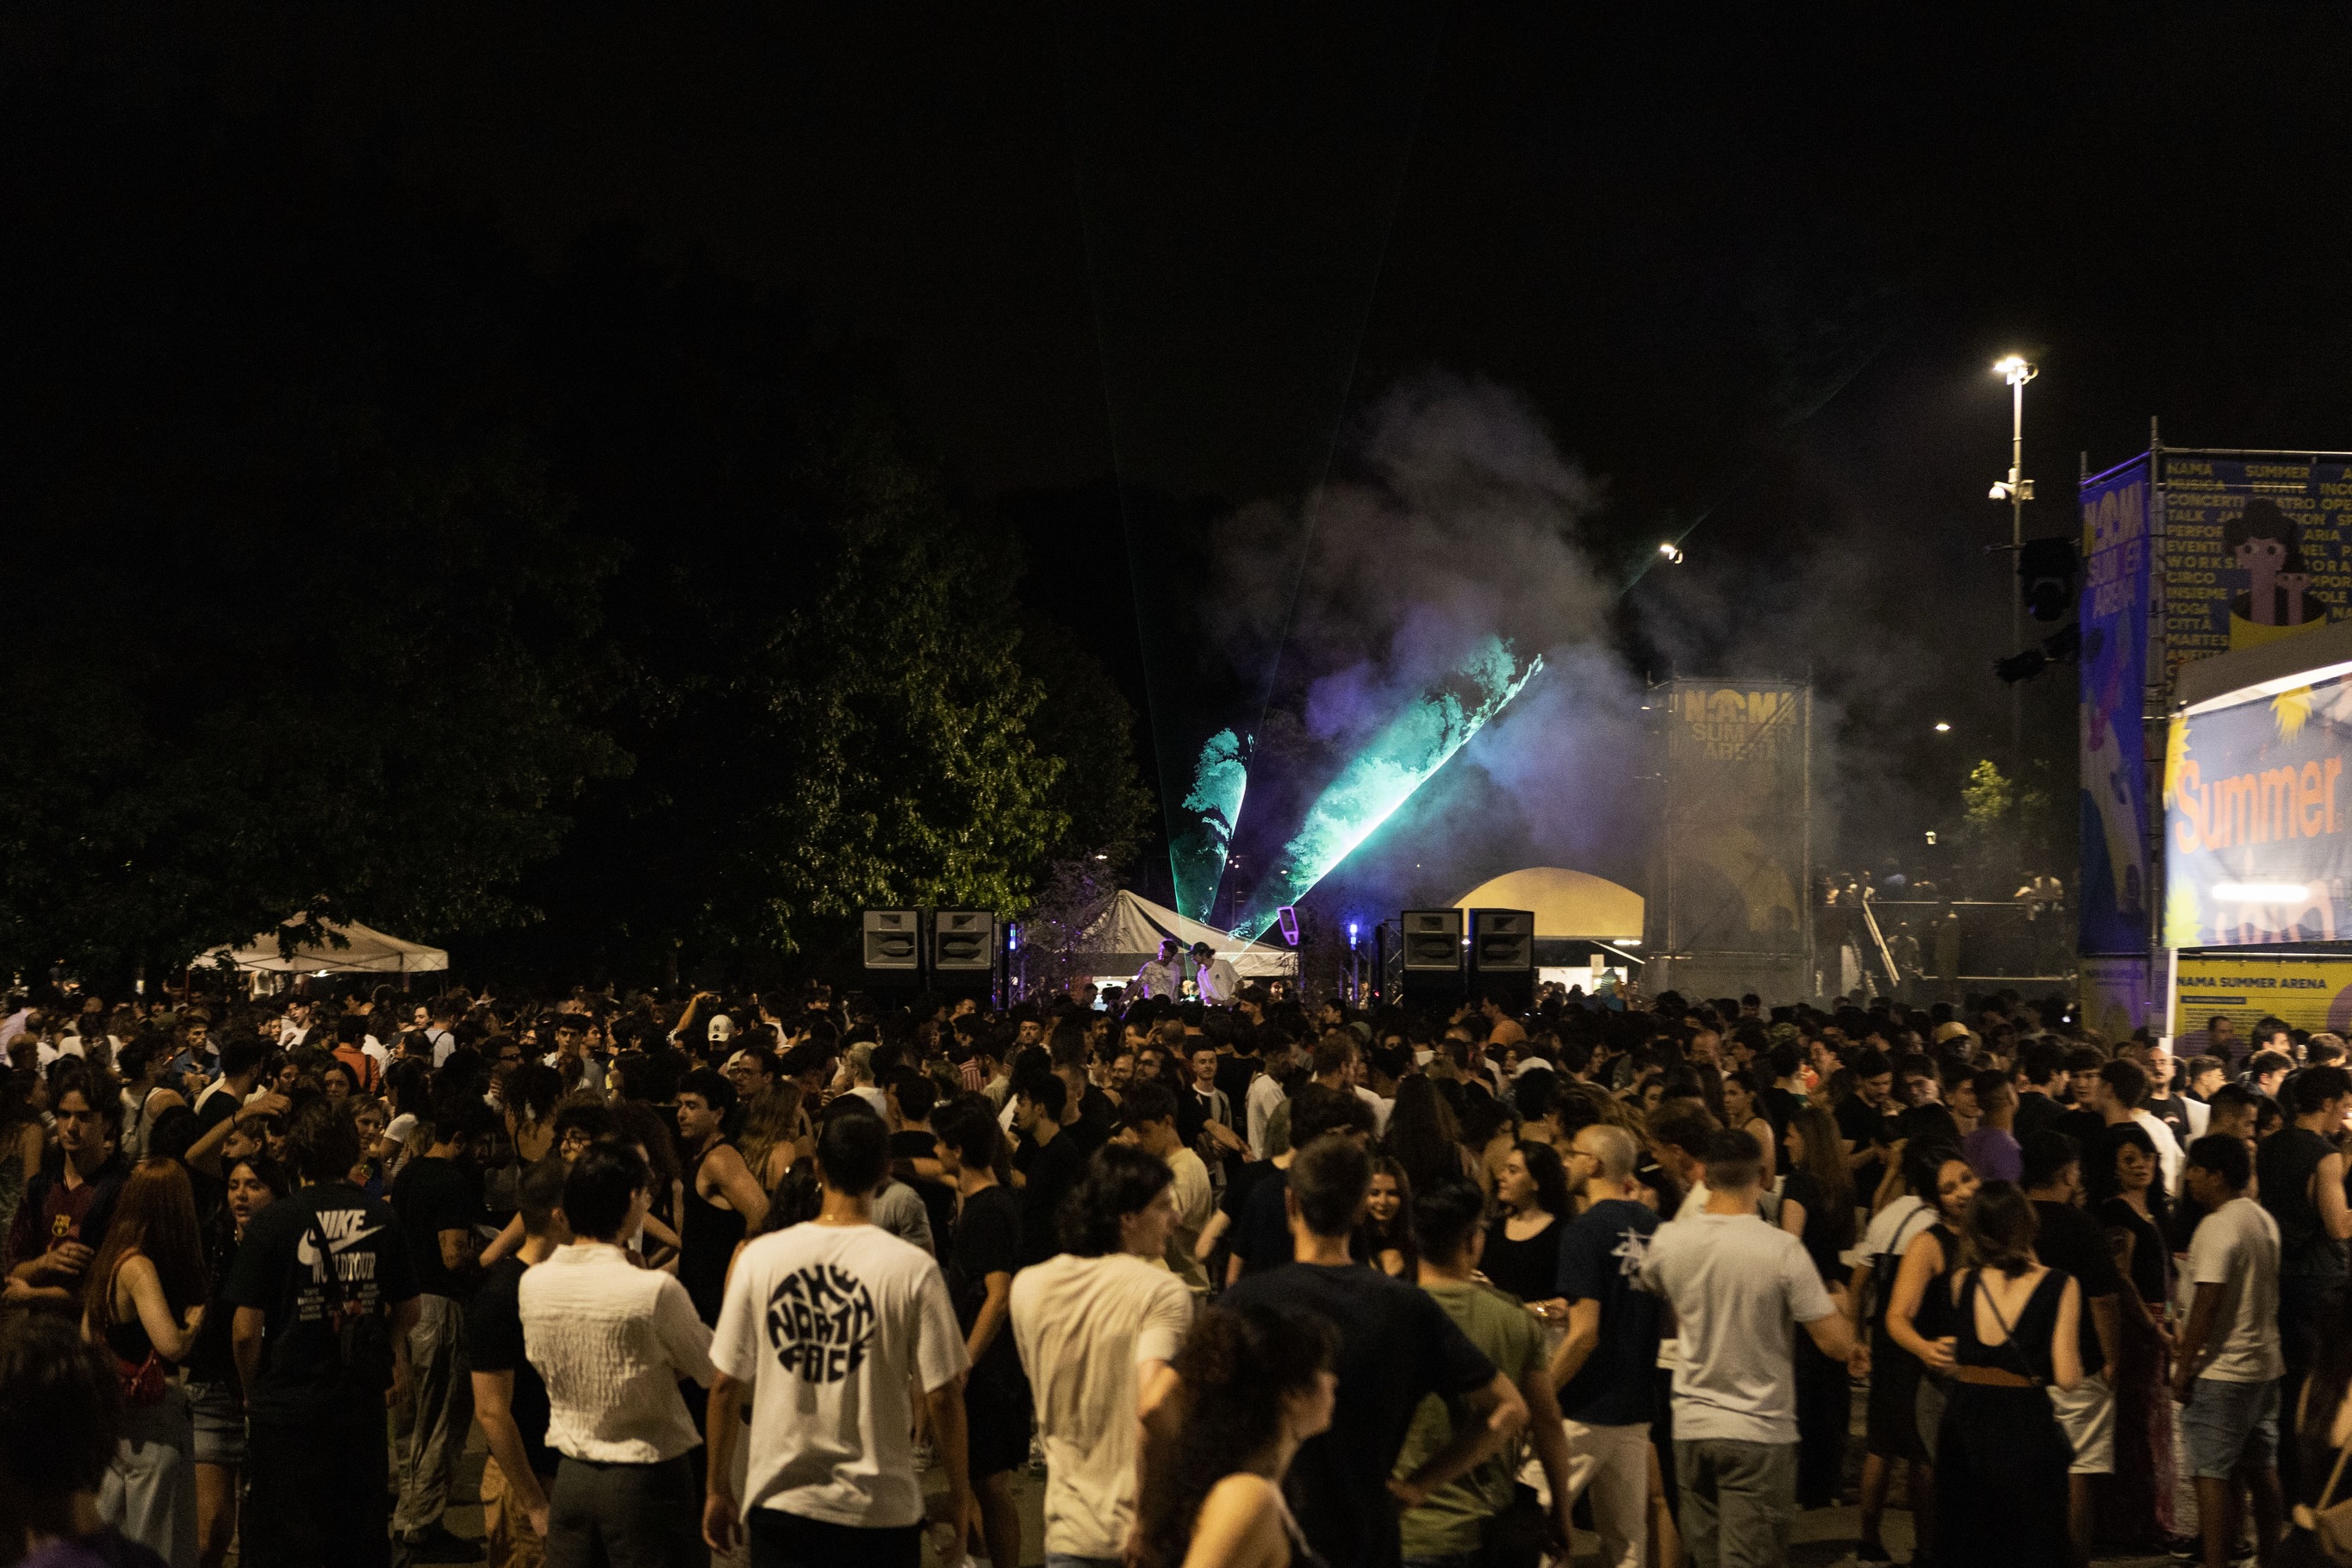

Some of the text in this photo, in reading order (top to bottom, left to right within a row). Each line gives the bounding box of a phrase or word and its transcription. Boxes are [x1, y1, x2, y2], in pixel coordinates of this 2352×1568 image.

[2166, 462, 2310, 479] NAMA SUMMER
[2166, 493, 2245, 507] CONCERTI
[2168, 508, 2206, 522] TALK
[2166, 570, 2216, 585] CIRCO
[2166, 586, 2229, 600] INSIEME
[2166, 601, 2211, 615] YOGA
[2175, 755, 2343, 854] Summer
[2177, 976, 2327, 990] NAMA SUMMER ARENA
[768, 1263, 859, 1309] THE
[767, 1284, 875, 1350] NORTH
[777, 1328, 876, 1383] FACE
